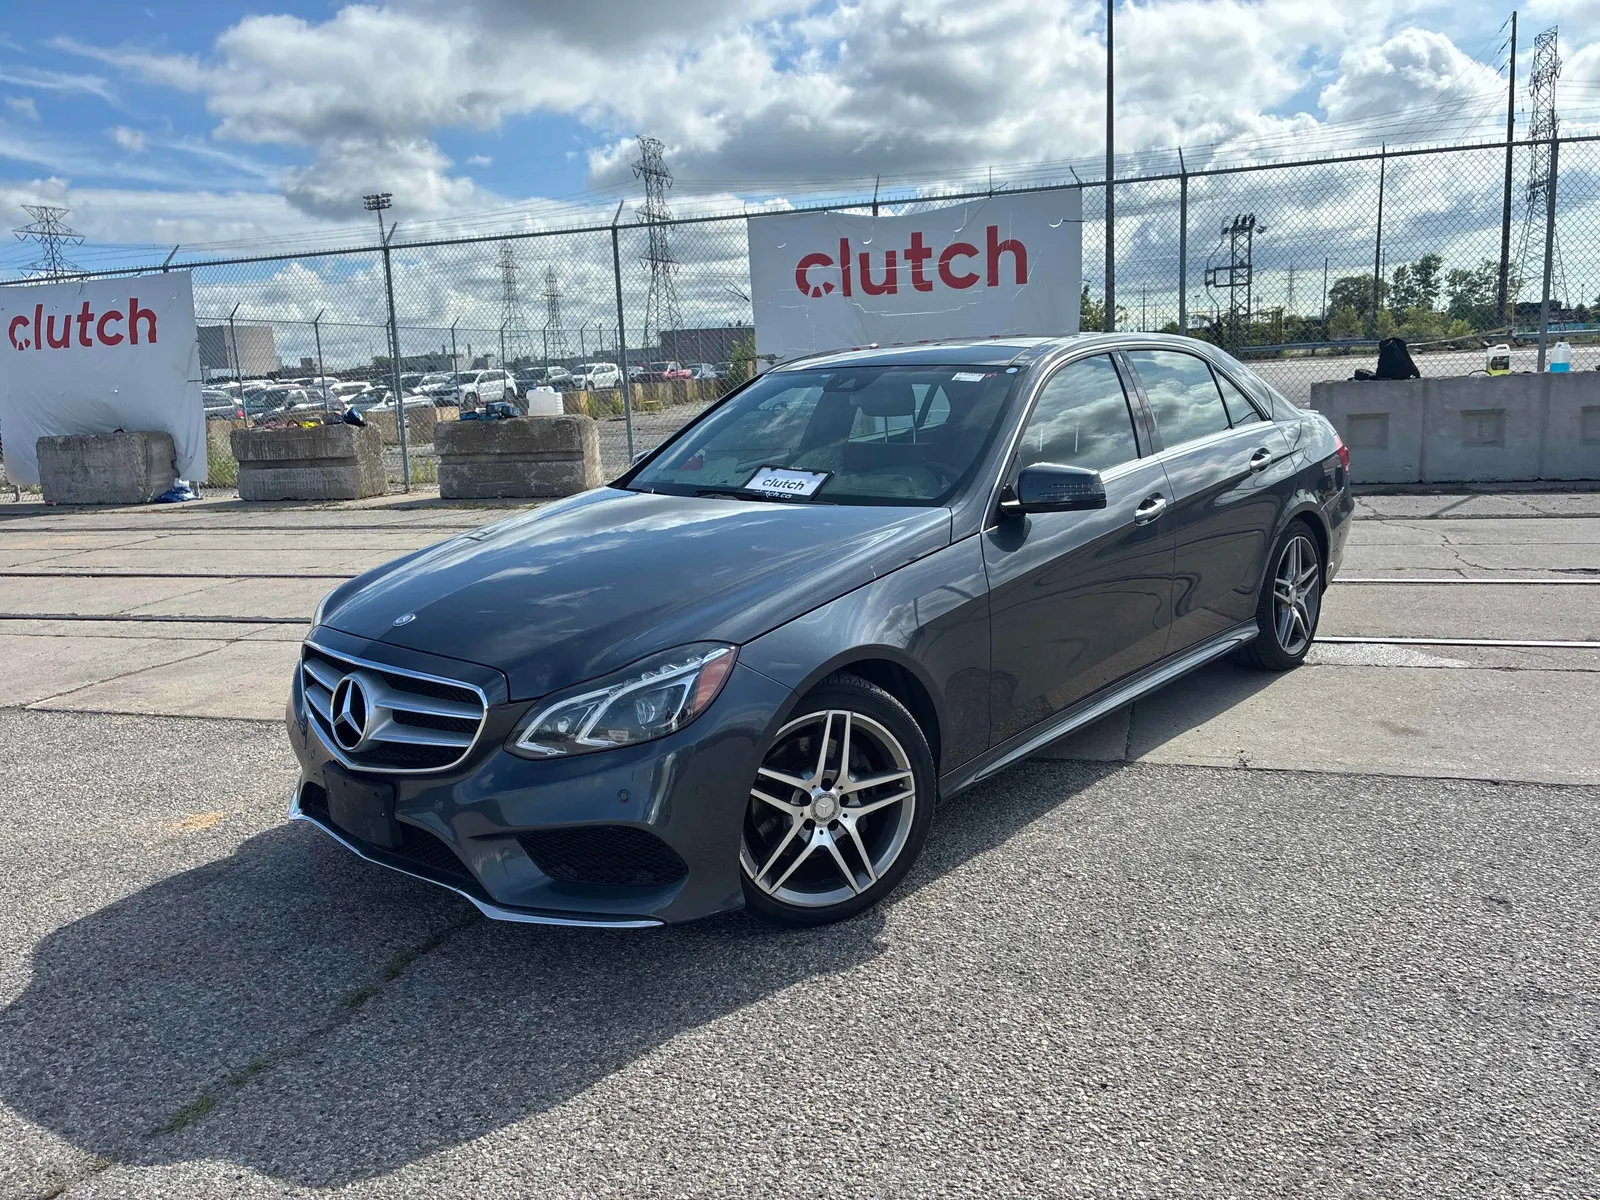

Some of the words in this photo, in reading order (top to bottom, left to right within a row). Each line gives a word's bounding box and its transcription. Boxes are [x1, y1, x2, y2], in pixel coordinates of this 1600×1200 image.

[795, 225, 1028, 298] clutch
[8, 297, 157, 351] clutch
[762, 478, 805, 491] clutch
